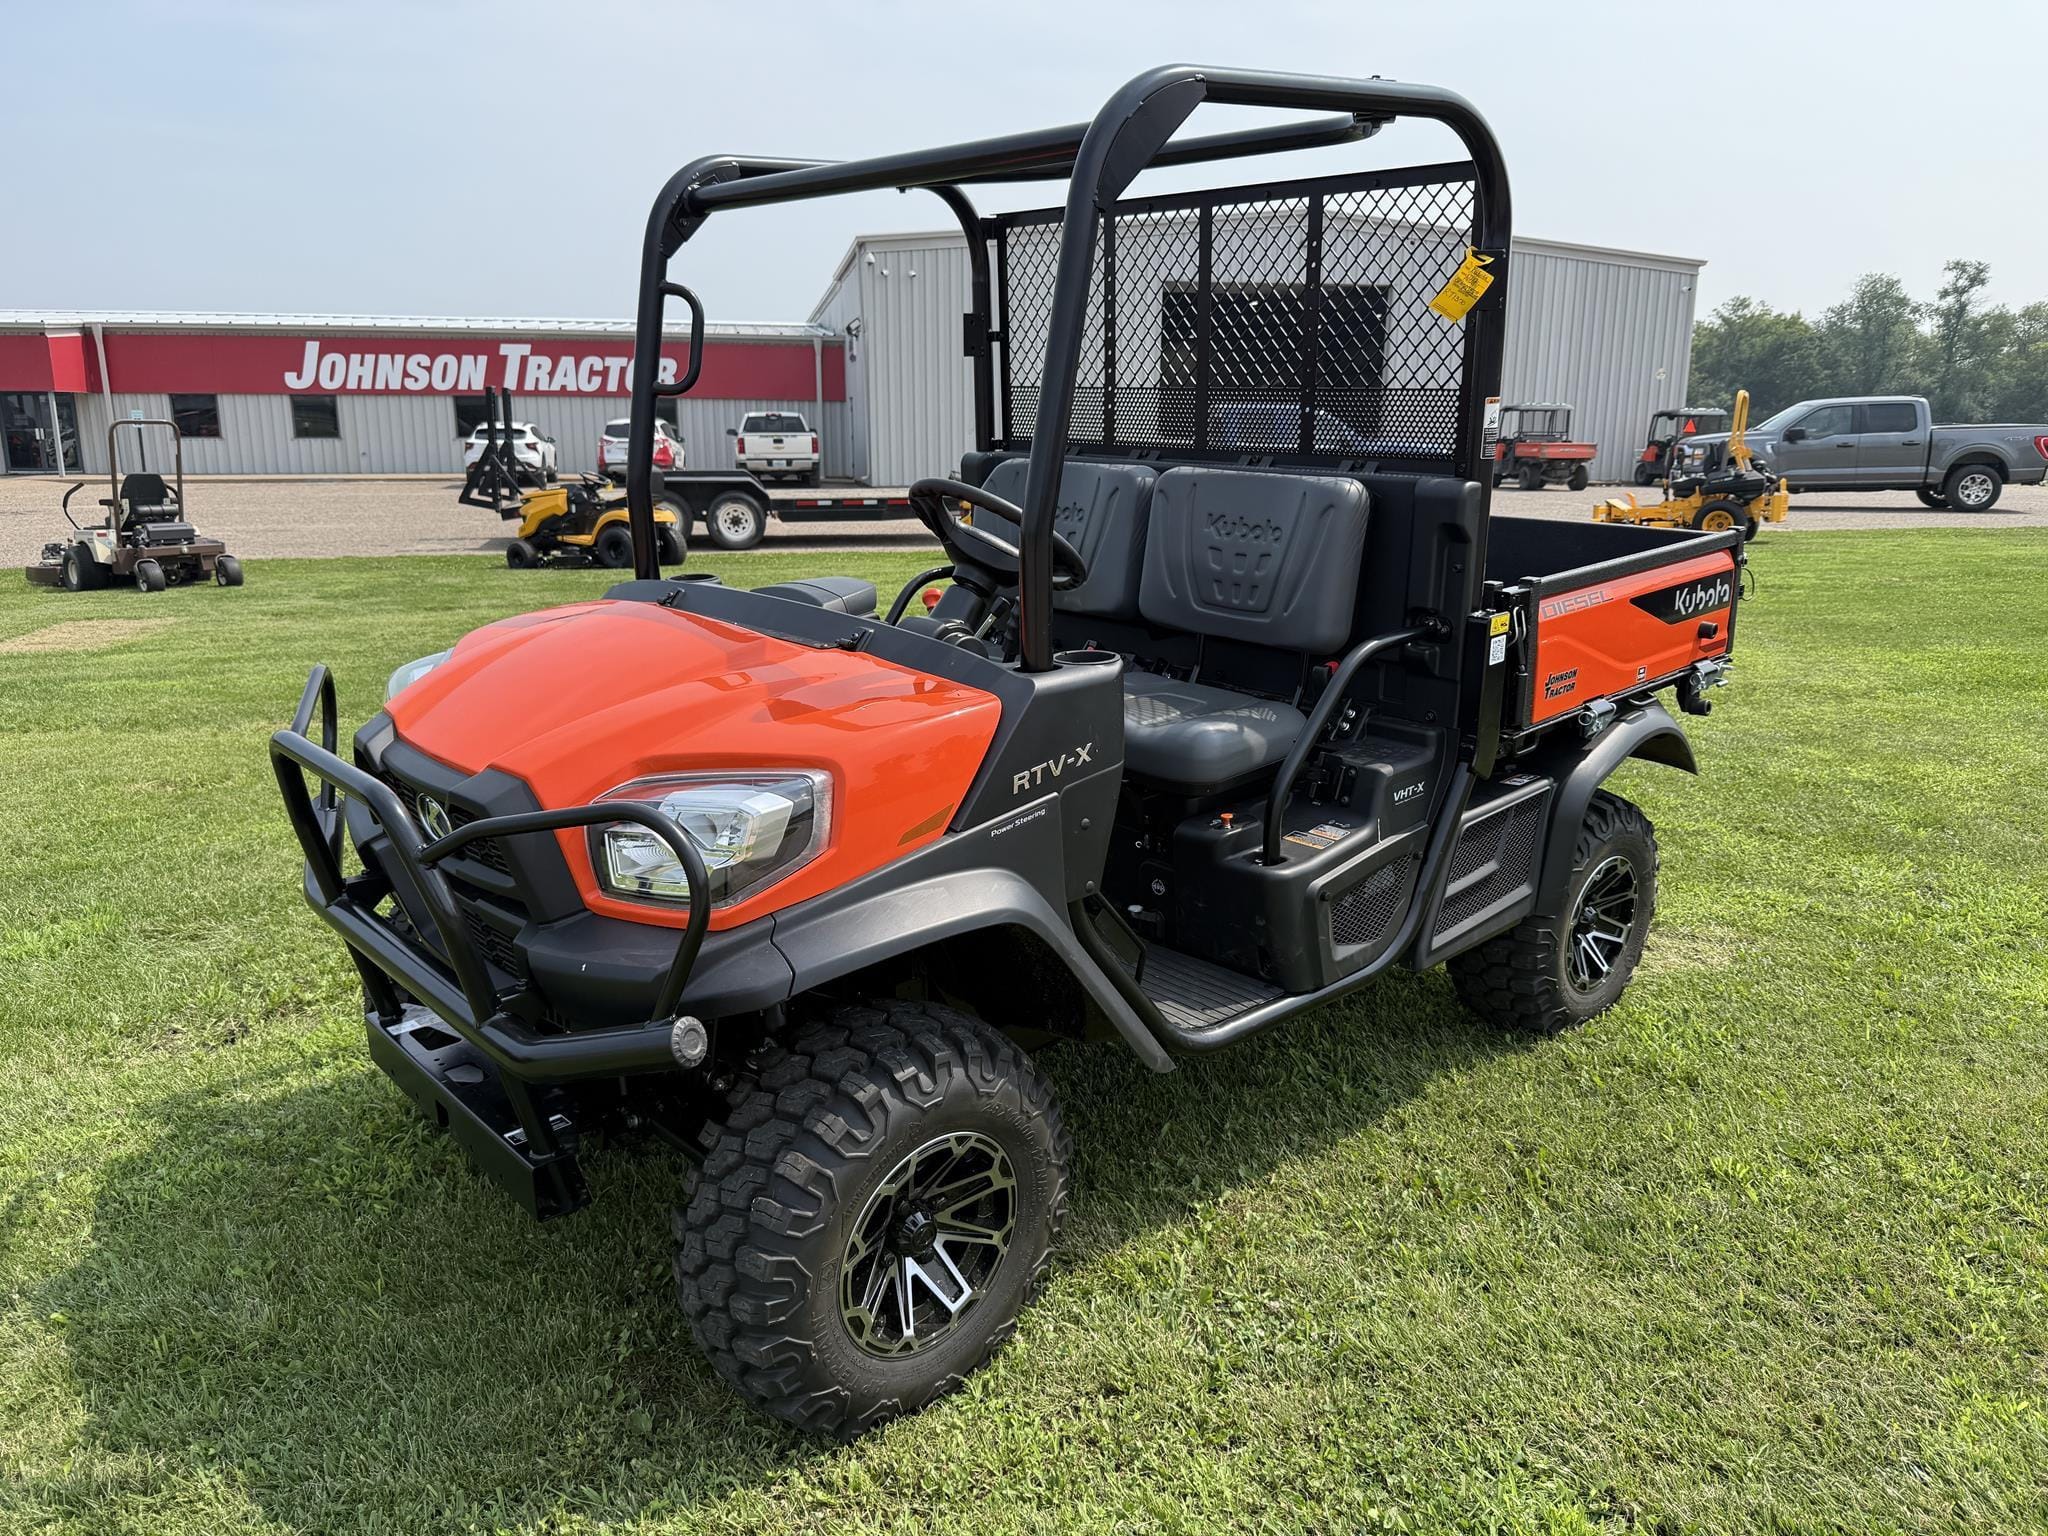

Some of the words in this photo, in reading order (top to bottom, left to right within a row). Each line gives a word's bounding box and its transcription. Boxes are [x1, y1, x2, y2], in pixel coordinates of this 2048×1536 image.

[284, 341, 488, 391] JOHNSON
[1207, 512, 1284, 544] Kubota
[1541, 590, 1615, 620] DIESEL
[1674, 578, 1731, 616] Kubota
[1544, 668, 1579, 687] JOHNSON
[1544, 682, 1576, 699] TRACTOR
[1013, 742, 1093, 795] RTV-X
[1393, 781, 1425, 802] VHT-X
[991, 822, 1015, 838] Power
[1014, 808, 1046, 827] Steering
